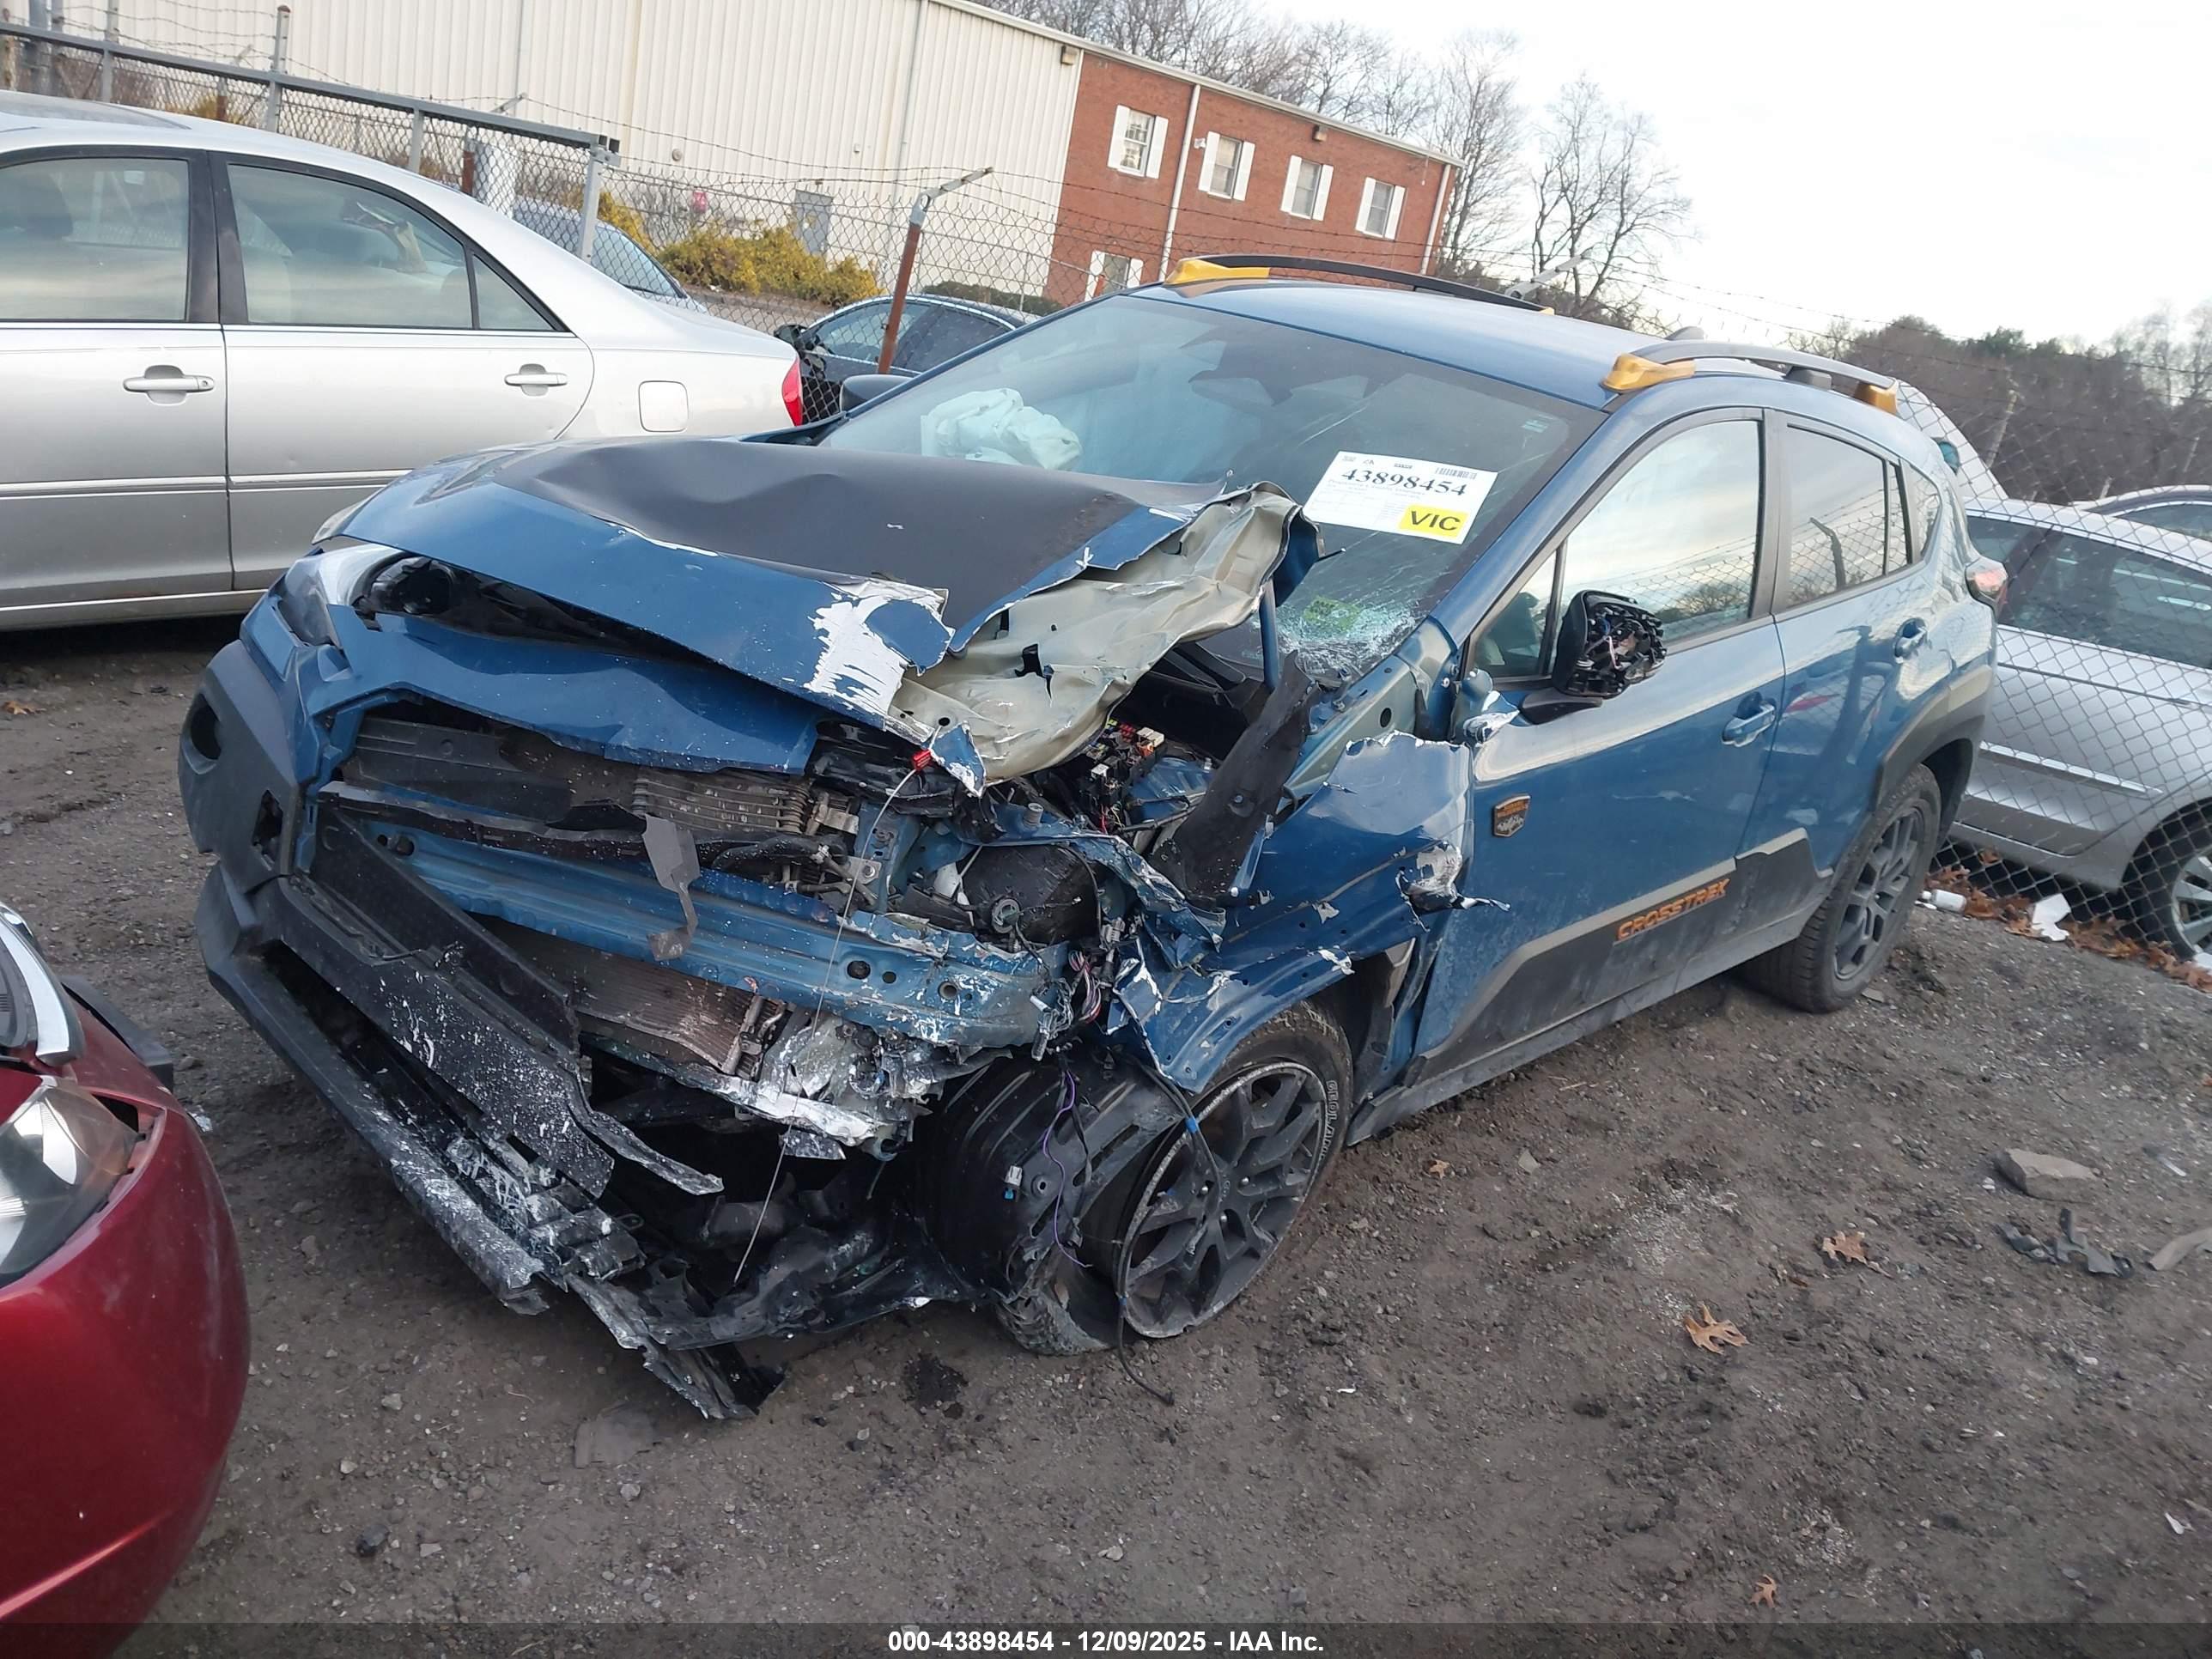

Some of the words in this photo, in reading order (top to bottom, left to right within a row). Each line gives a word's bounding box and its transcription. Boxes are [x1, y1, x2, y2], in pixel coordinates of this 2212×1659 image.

[1341, 468, 1468, 496] 43898454
[1410, 510, 1461, 532] VIC
[1618, 878, 1731, 940] CROSSTREK
